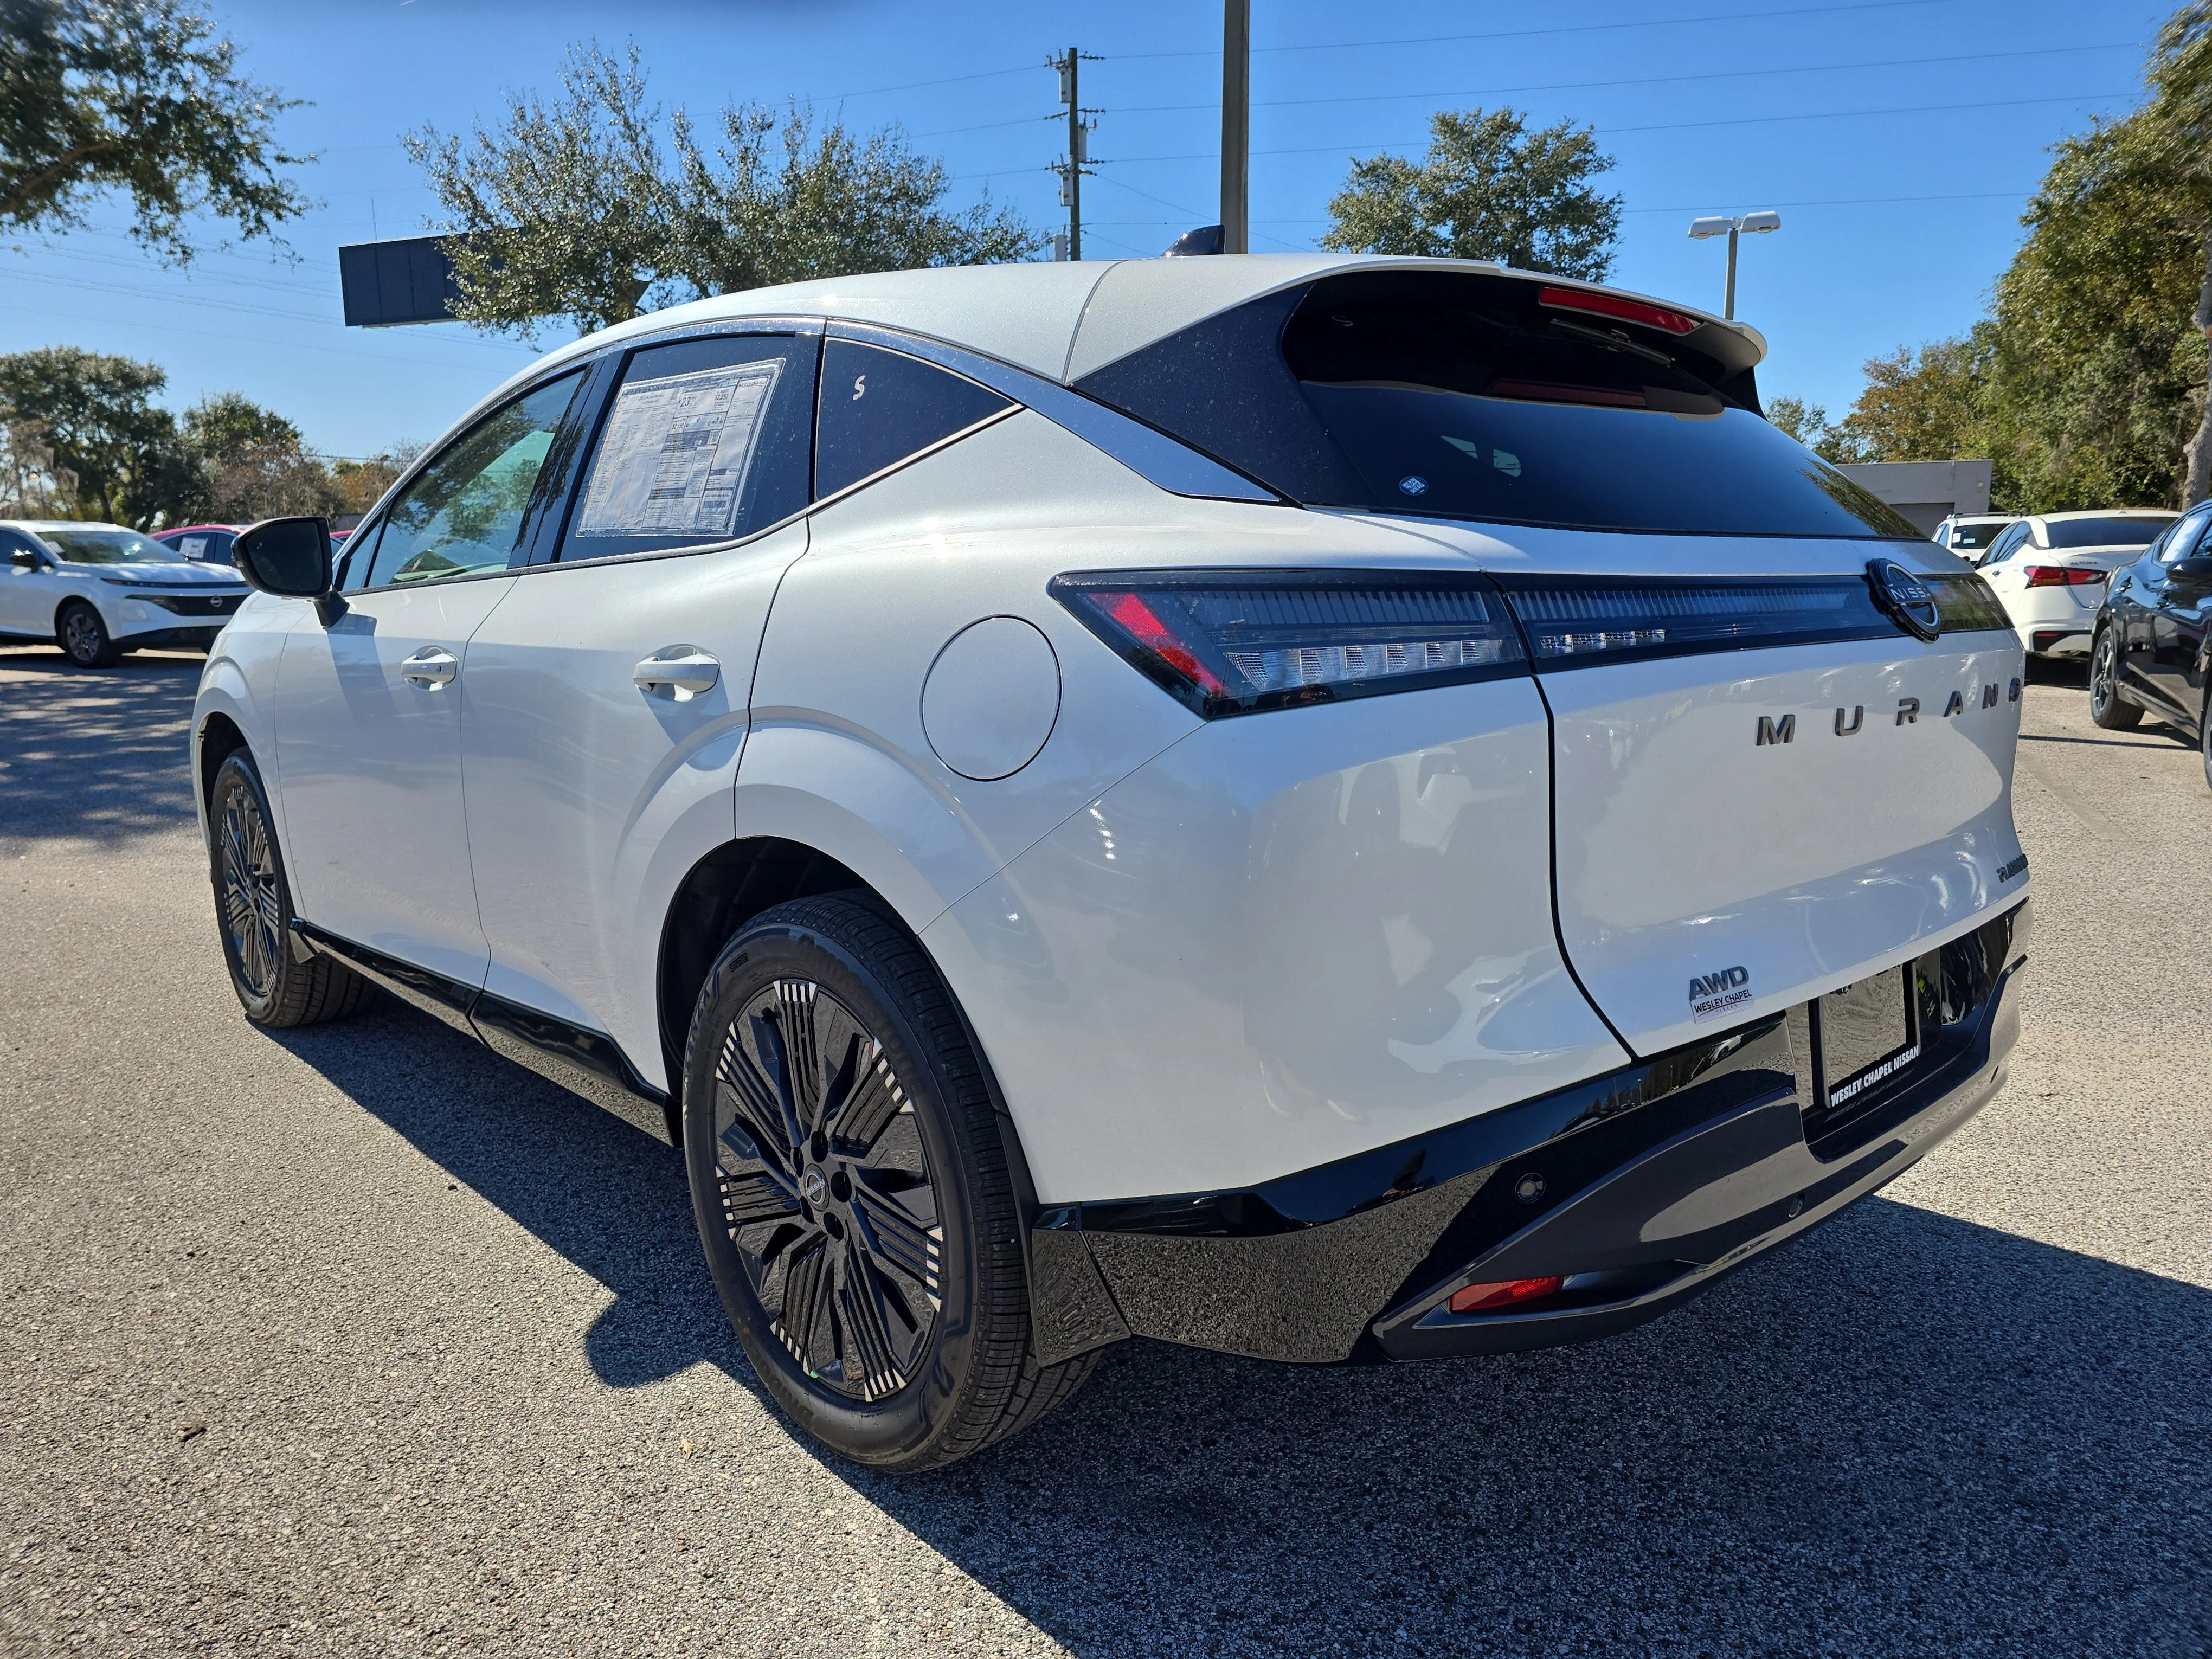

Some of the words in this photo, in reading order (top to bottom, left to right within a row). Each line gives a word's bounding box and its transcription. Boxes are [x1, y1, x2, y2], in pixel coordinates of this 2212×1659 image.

[1756, 677, 2021, 746] MURANO
[1689, 966, 1749, 1001] AWD
[1694, 996, 1723, 1013] WESLEY
[1725, 988, 1752, 1003] CHAPEL
[1831, 1078, 1862, 1107] WESLEY
[1863, 1061, 1893, 1088] CHAPEL
[1893, 1044, 1919, 1071] NISSAN
